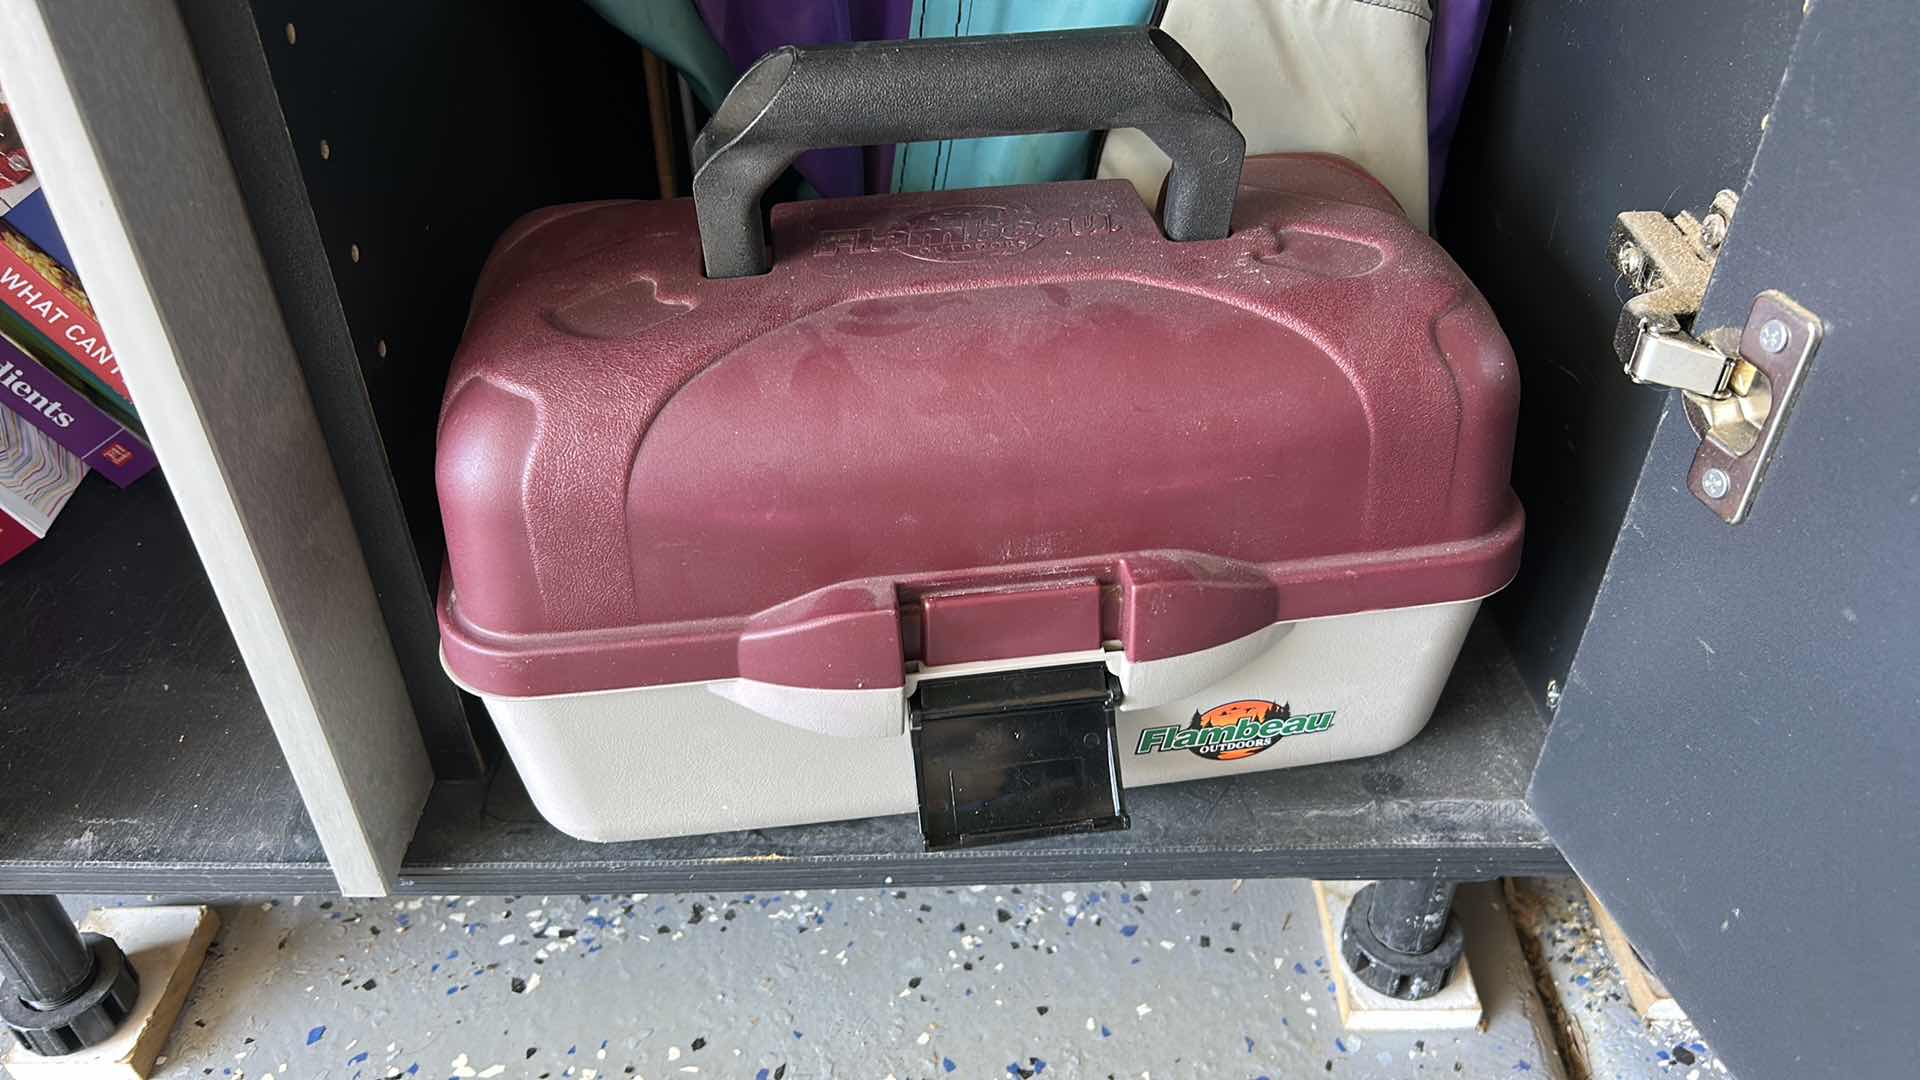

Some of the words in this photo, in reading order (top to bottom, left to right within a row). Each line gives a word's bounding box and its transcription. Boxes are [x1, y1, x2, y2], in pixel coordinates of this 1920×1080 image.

[0, 267, 69, 324] WHAT
[1136, 711, 1335, 755] Flambeau
[1199, 737, 1271, 754] OUTDOORS
